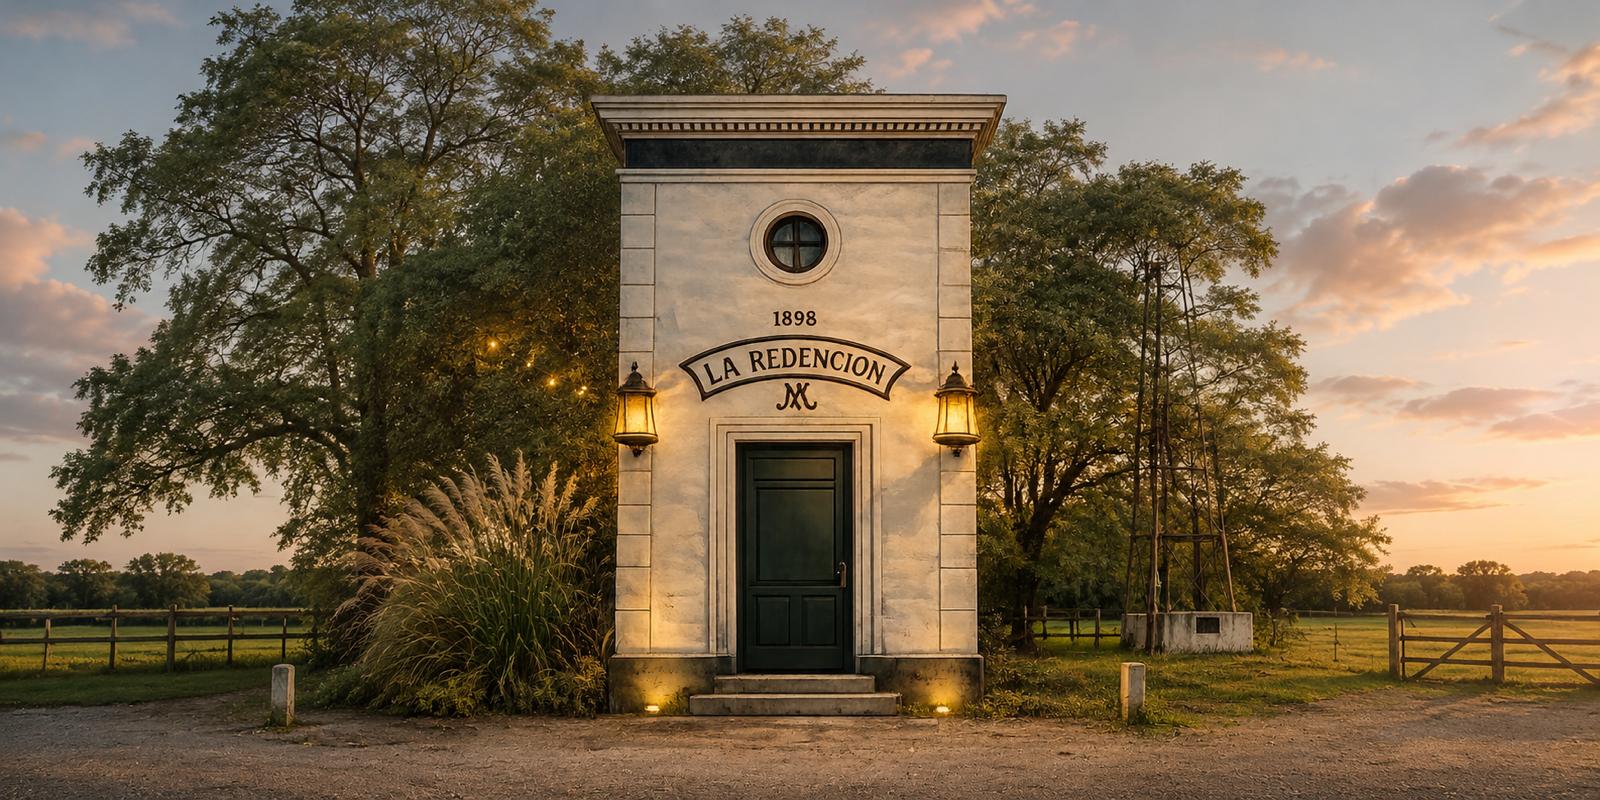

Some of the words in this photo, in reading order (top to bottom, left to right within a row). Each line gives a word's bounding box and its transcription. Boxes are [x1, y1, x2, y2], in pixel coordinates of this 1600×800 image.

[773, 310, 817, 326] 1898
[703, 357, 741, 385] LA
[749, 347, 886, 385] REDENCION
